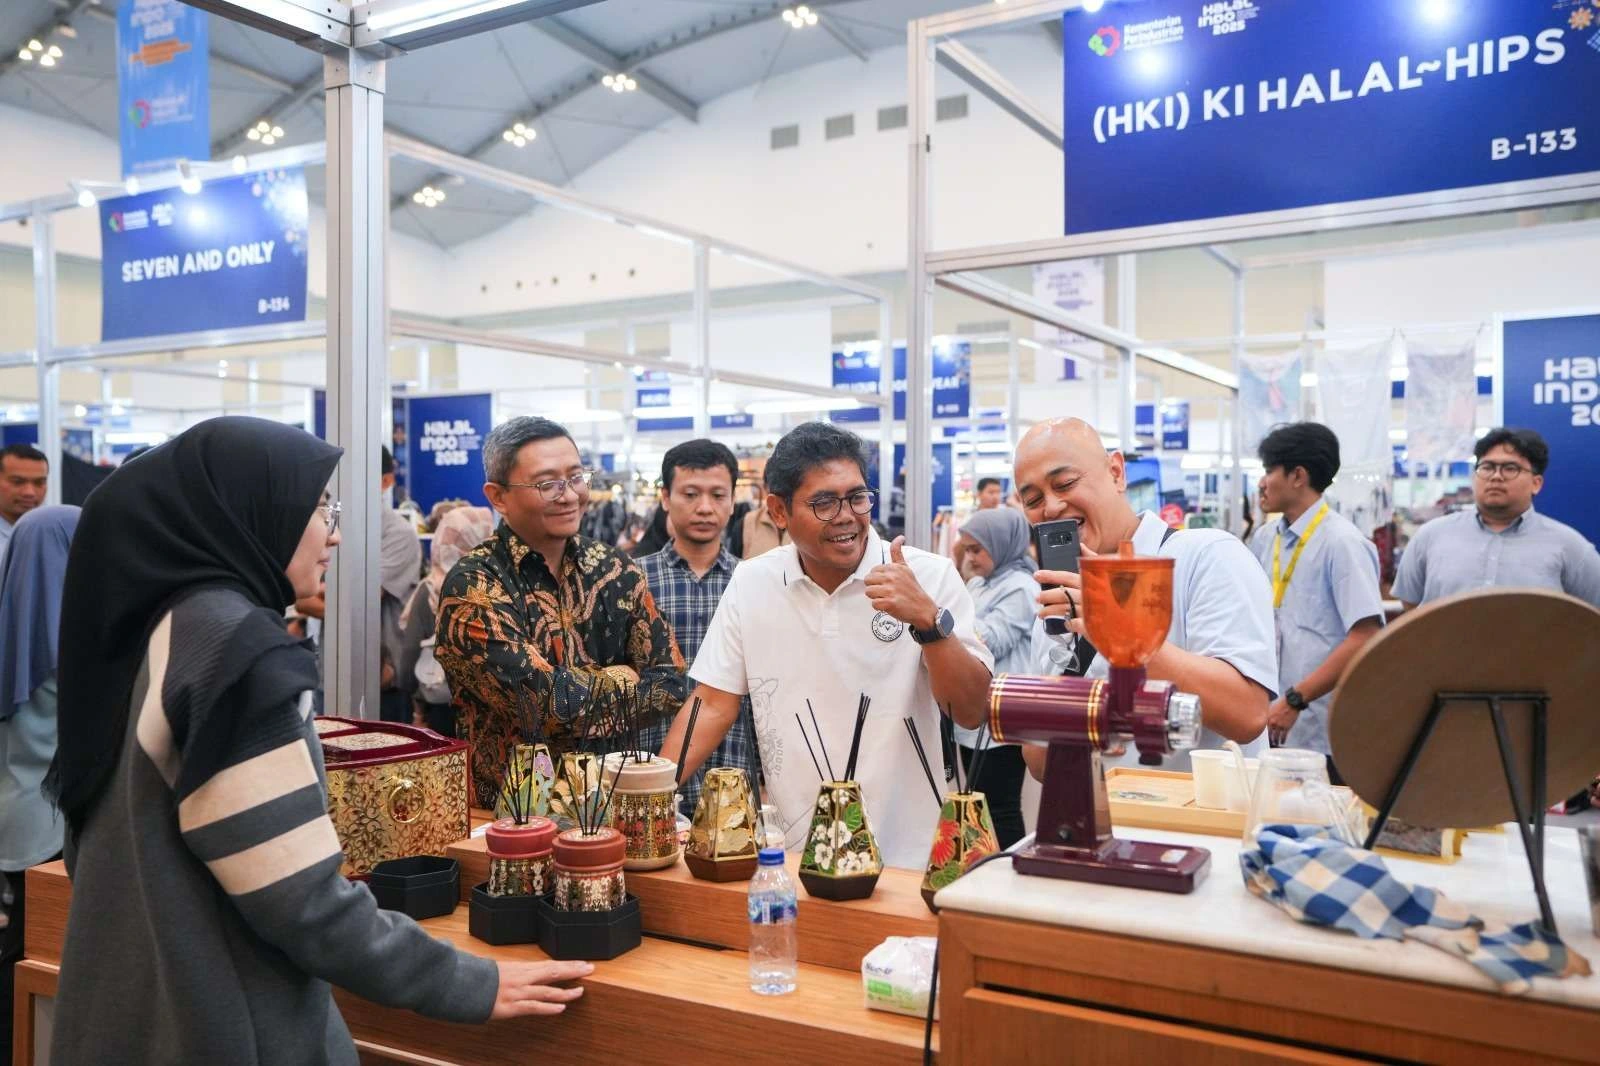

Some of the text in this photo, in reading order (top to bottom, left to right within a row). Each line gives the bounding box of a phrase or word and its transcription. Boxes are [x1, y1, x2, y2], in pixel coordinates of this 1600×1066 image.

[1212, 20, 1246, 36] 2025
[1093, 91, 1190, 143] (HKI)
[1203, 84, 1244, 121] KI
[1491, 127, 1577, 160] B-133
[121, 240, 275, 283] SEVEN AND ONLY
[434, 450, 469, 466] 2025
